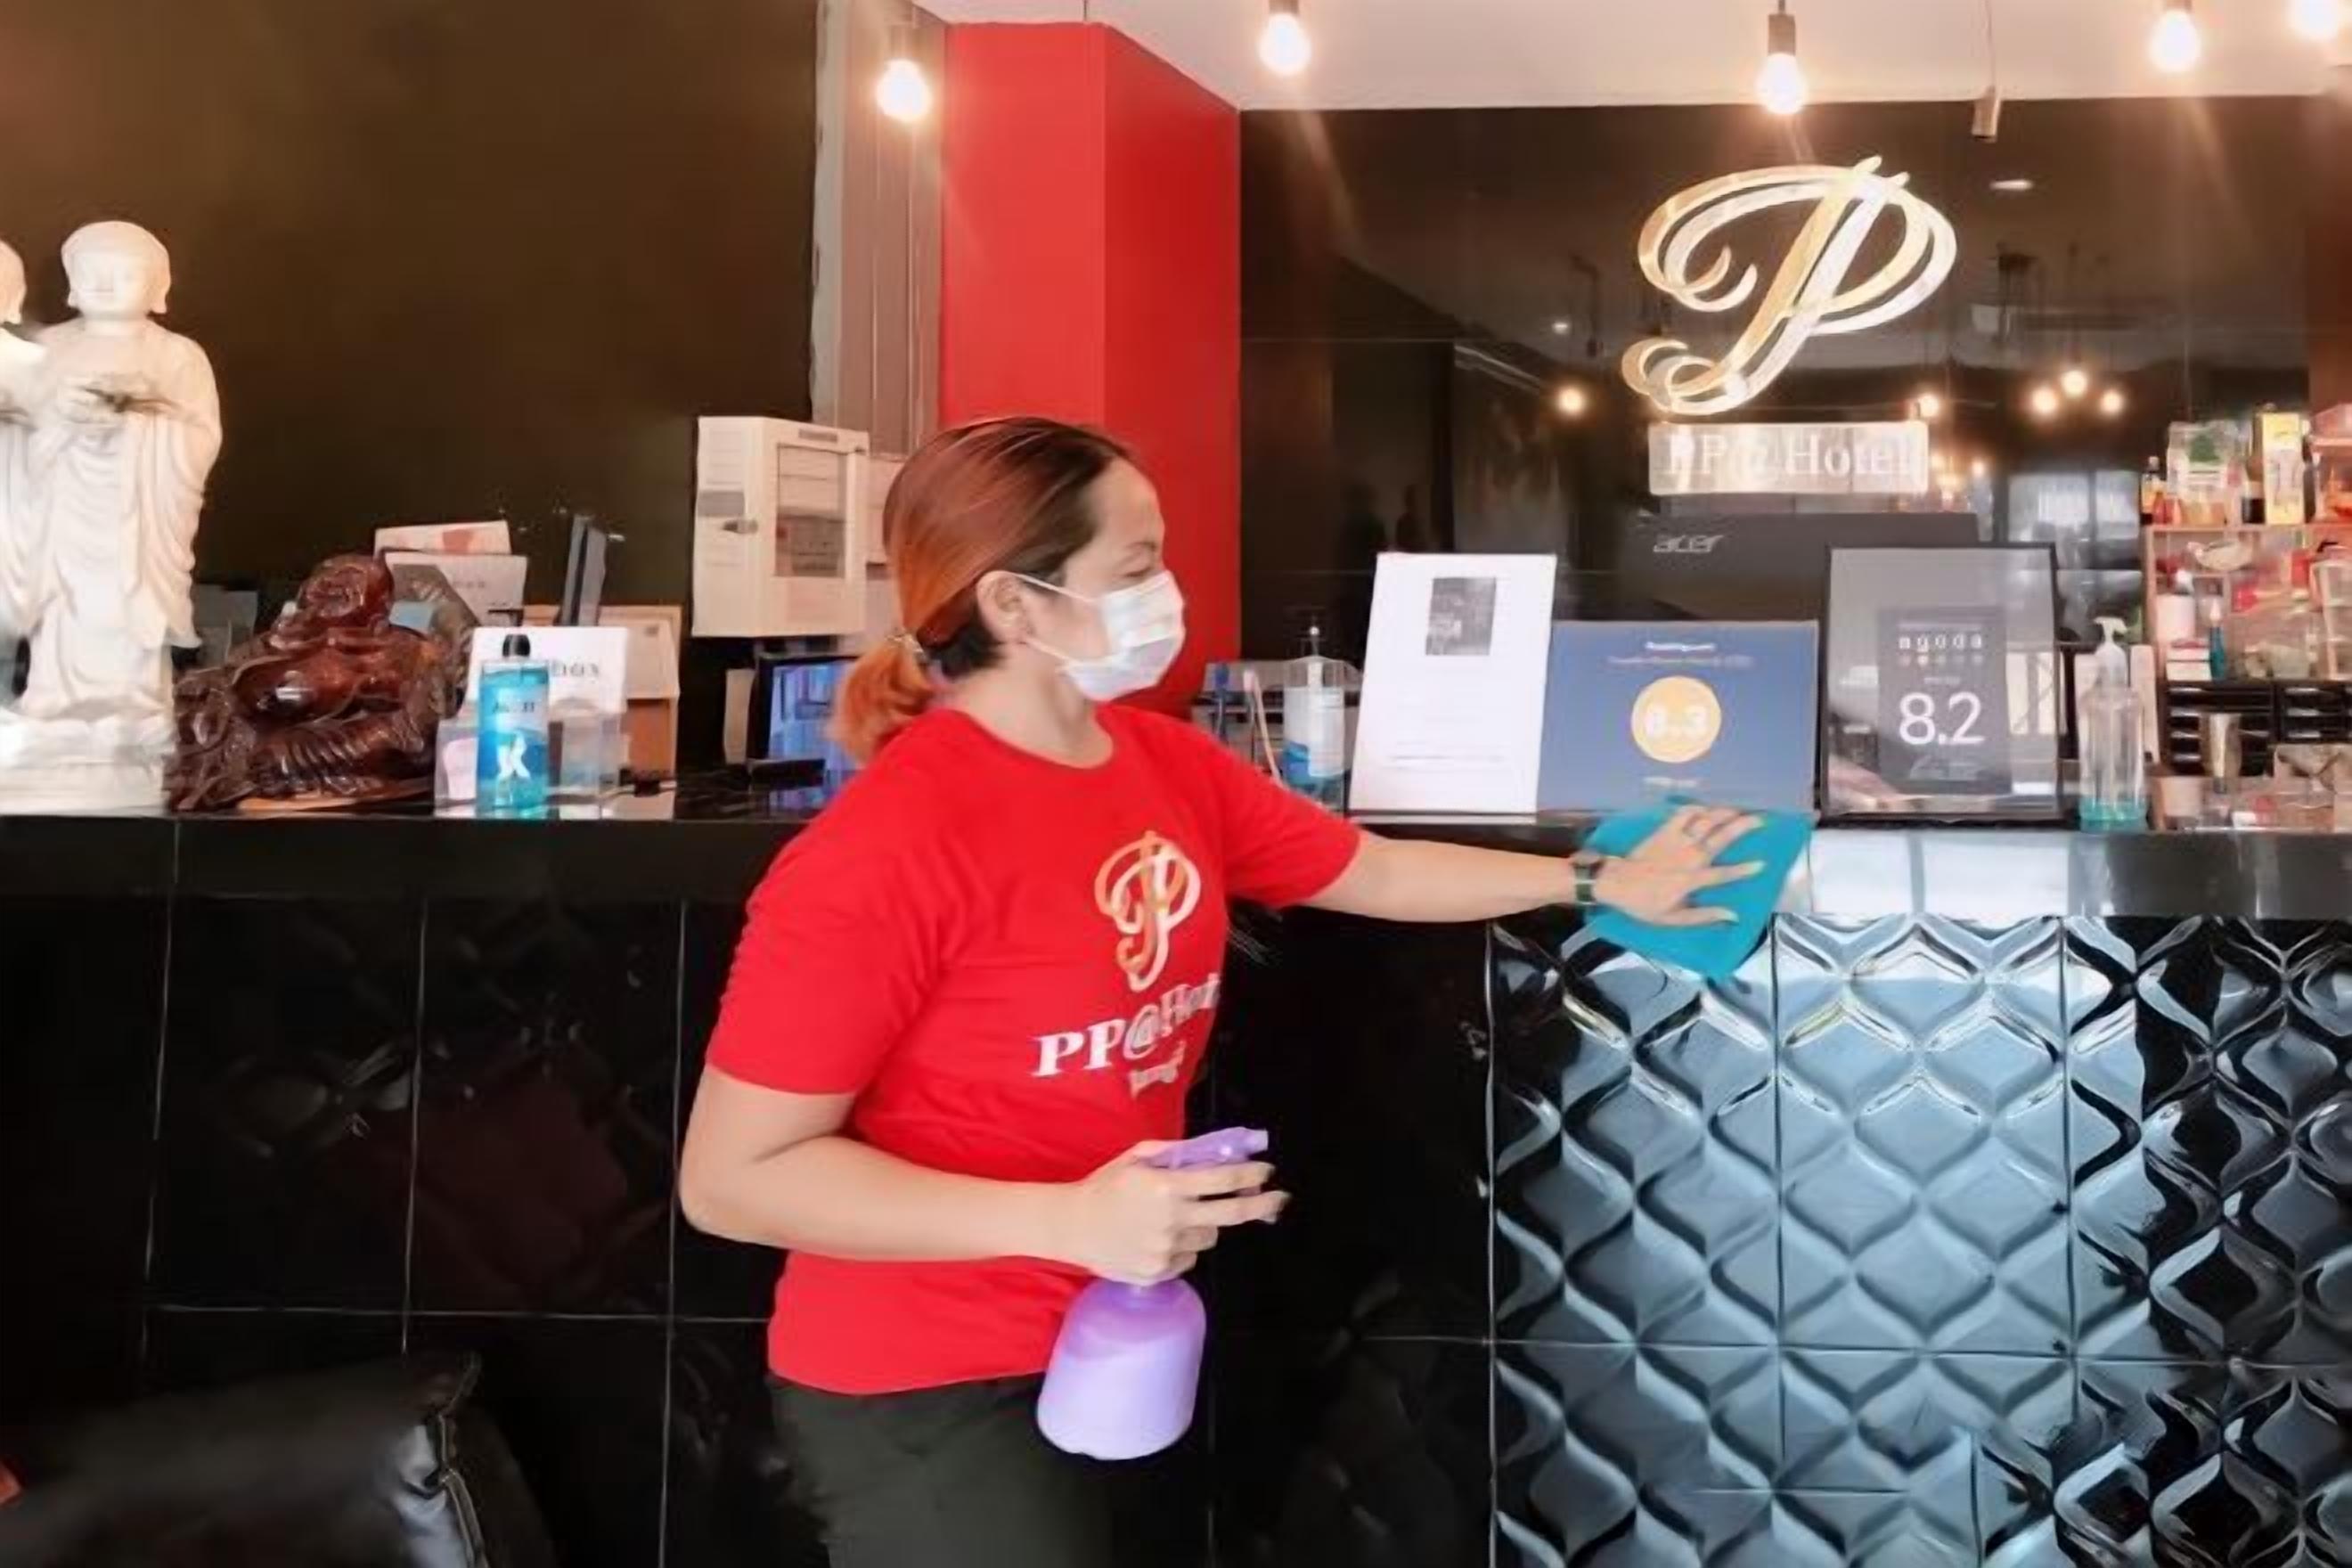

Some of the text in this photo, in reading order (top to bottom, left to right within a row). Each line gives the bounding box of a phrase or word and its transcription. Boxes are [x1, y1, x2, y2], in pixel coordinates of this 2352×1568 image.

[1654, 533, 1725, 554] acer
[1899, 633, 1984, 652] agoda
[1899, 691, 1986, 746] 8.2
